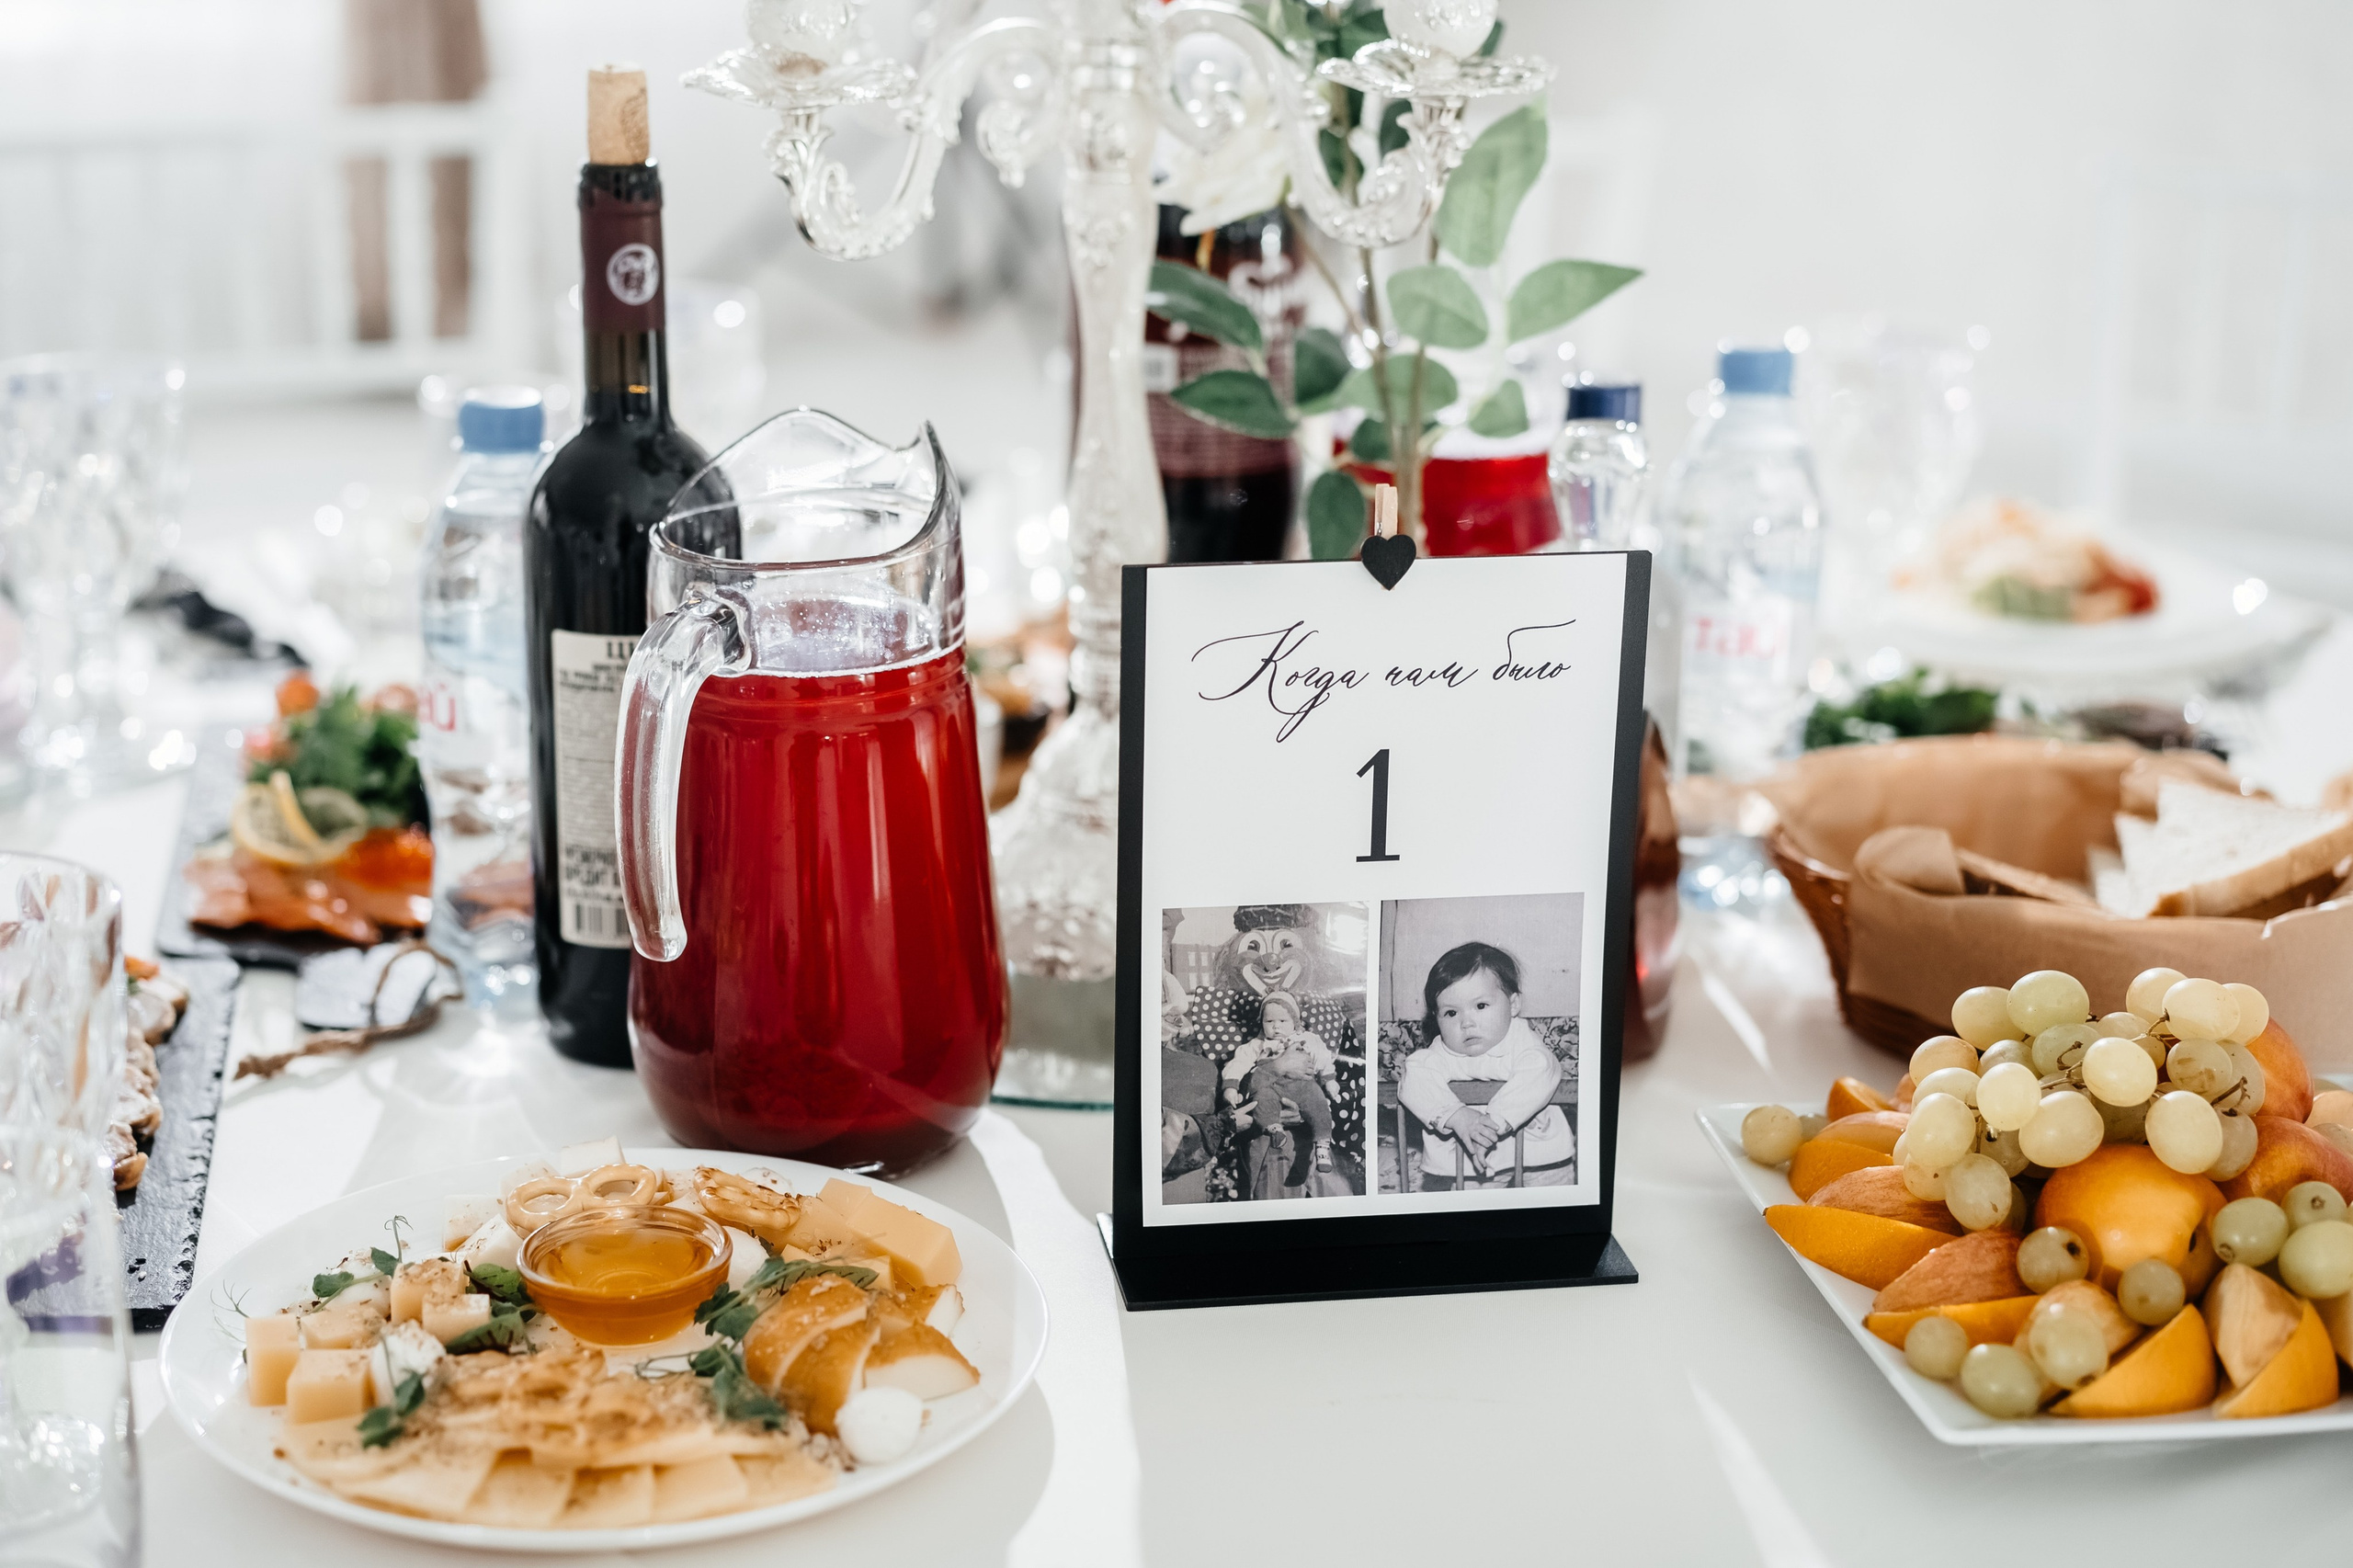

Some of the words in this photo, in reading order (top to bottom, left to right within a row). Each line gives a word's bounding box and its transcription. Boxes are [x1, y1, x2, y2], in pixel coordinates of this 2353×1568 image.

[1191, 620, 1370, 743] Когда
[1385, 661, 1478, 687] нам
[1493, 619, 1575, 681] было
[1356, 748, 1400, 863] 1
